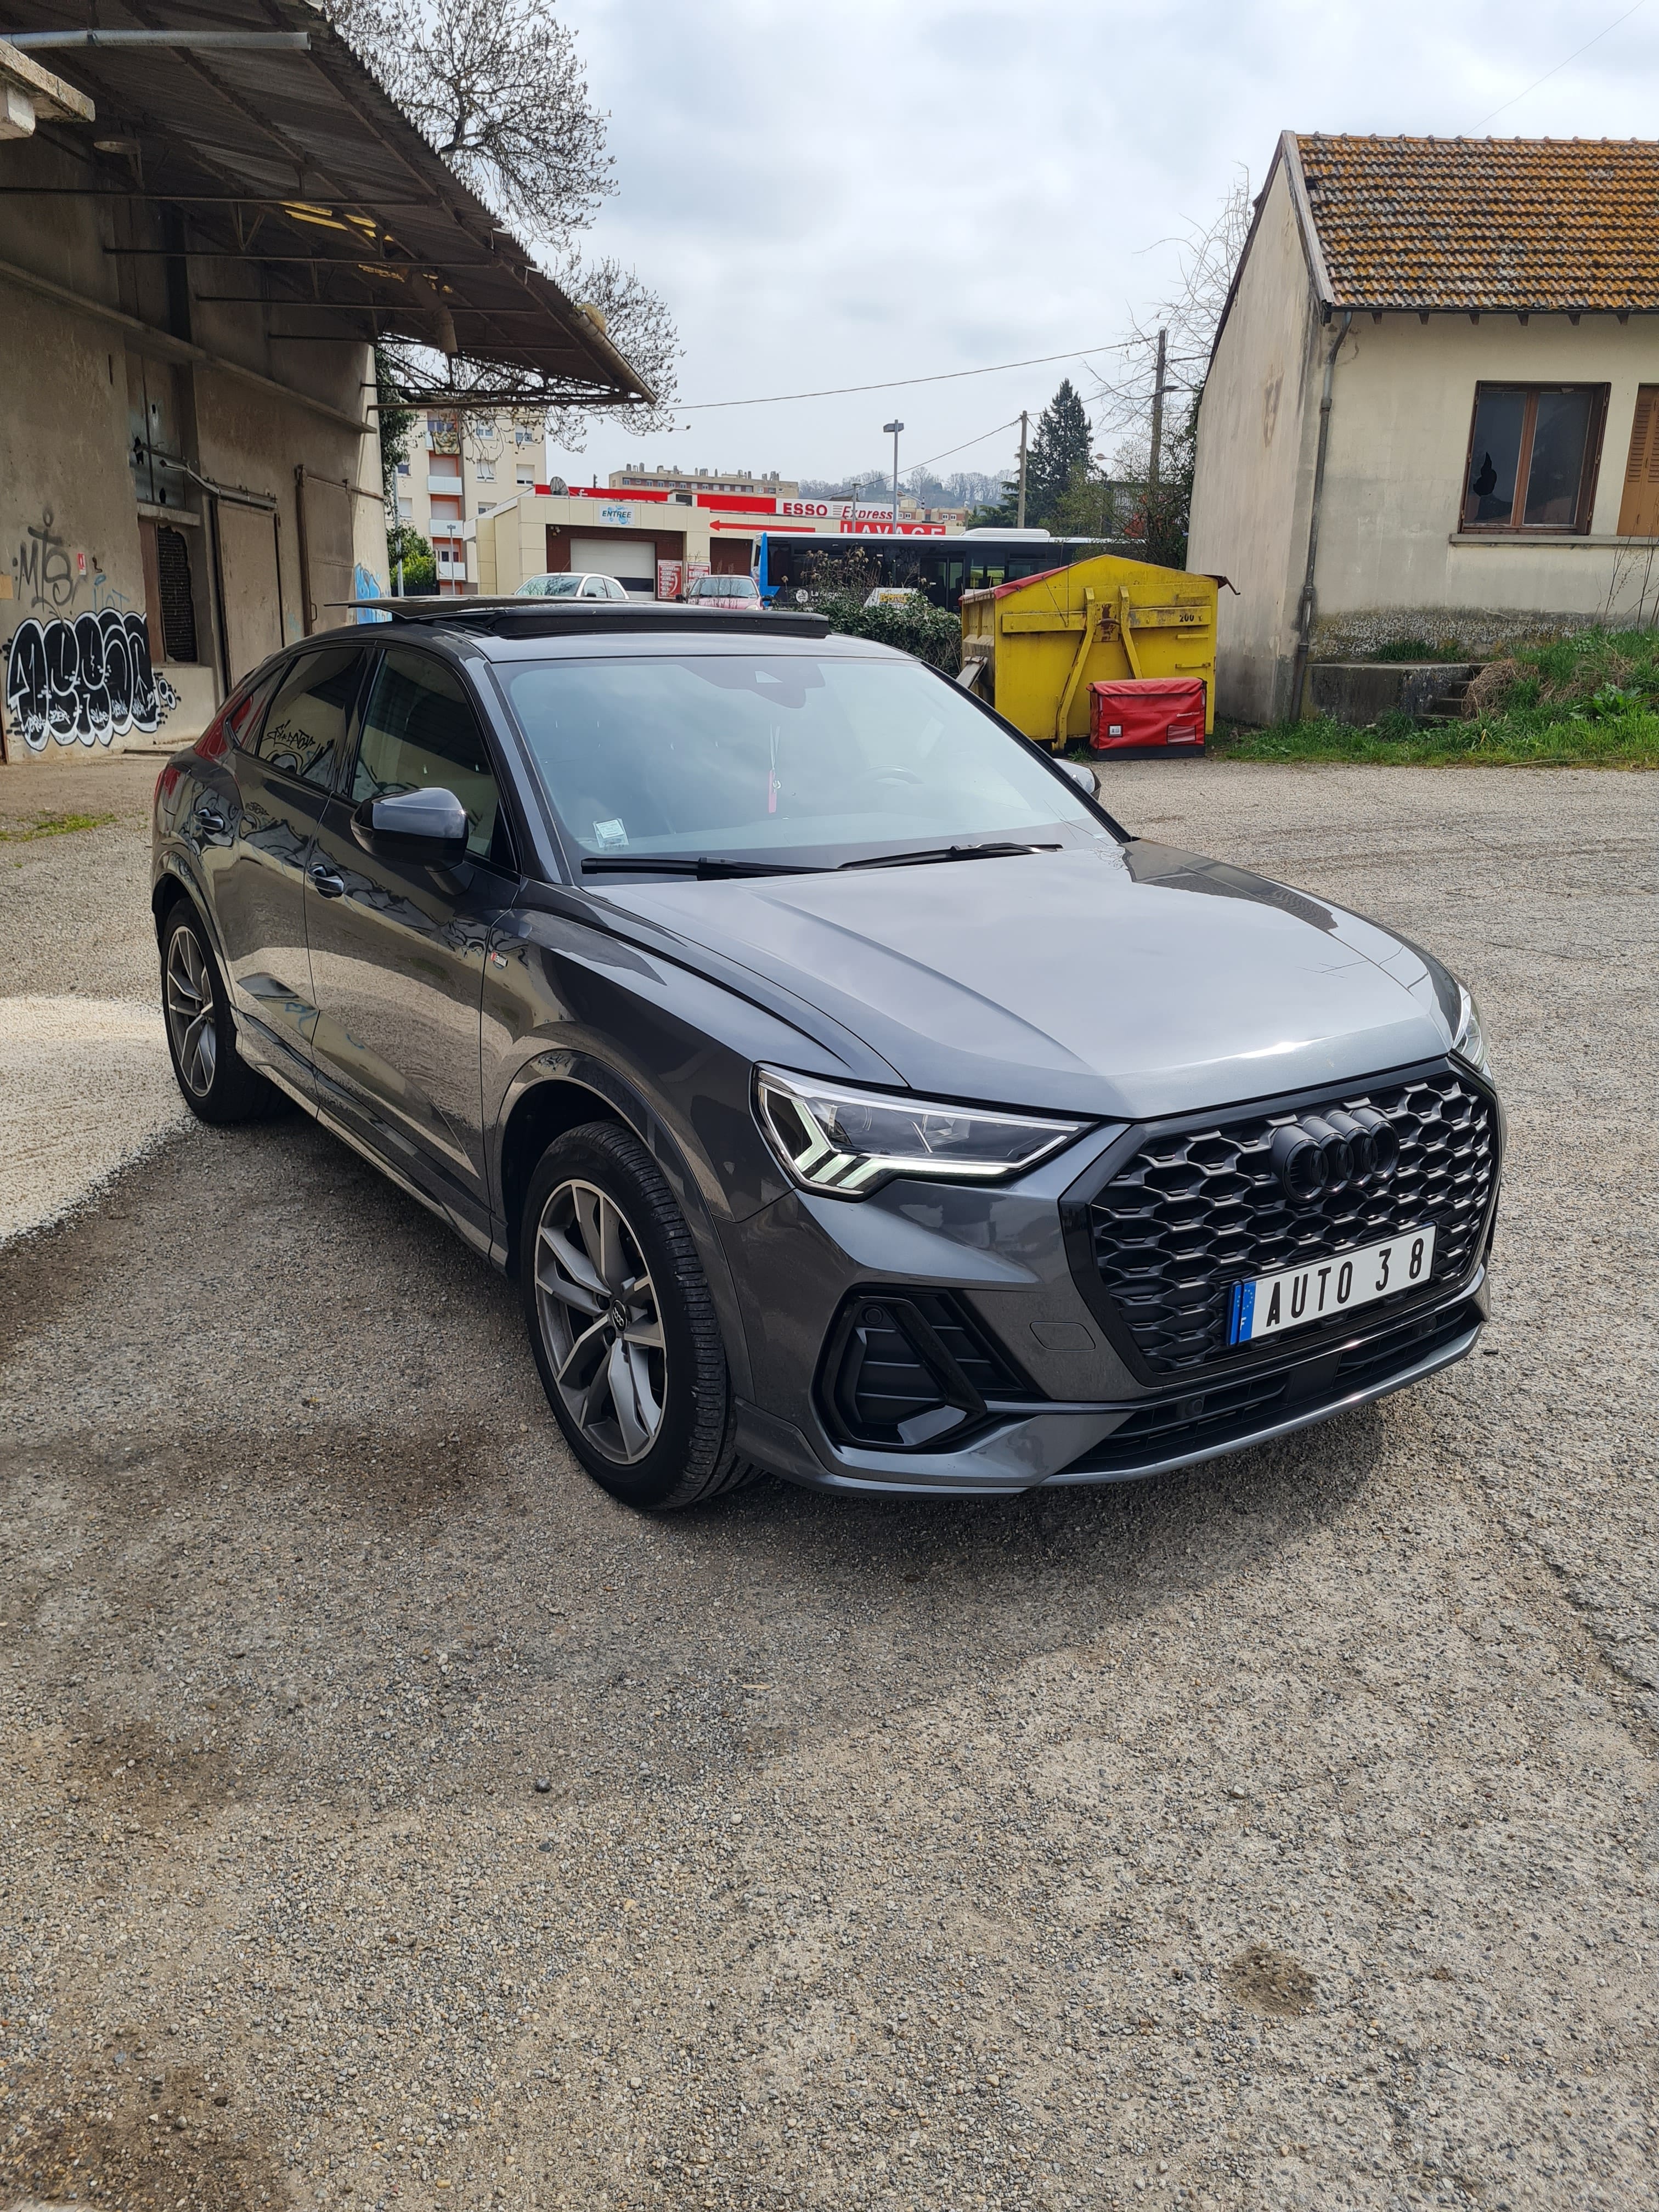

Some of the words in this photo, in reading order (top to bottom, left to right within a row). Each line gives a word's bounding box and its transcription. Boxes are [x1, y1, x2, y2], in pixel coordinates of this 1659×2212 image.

[602, 510, 632, 518] ENTREE
[783, 503, 828, 516] ESSO
[842, 506, 894, 520] Express
[1180, 613, 1194, 623] 200
[1266, 1261, 1353, 1328] AUTO
